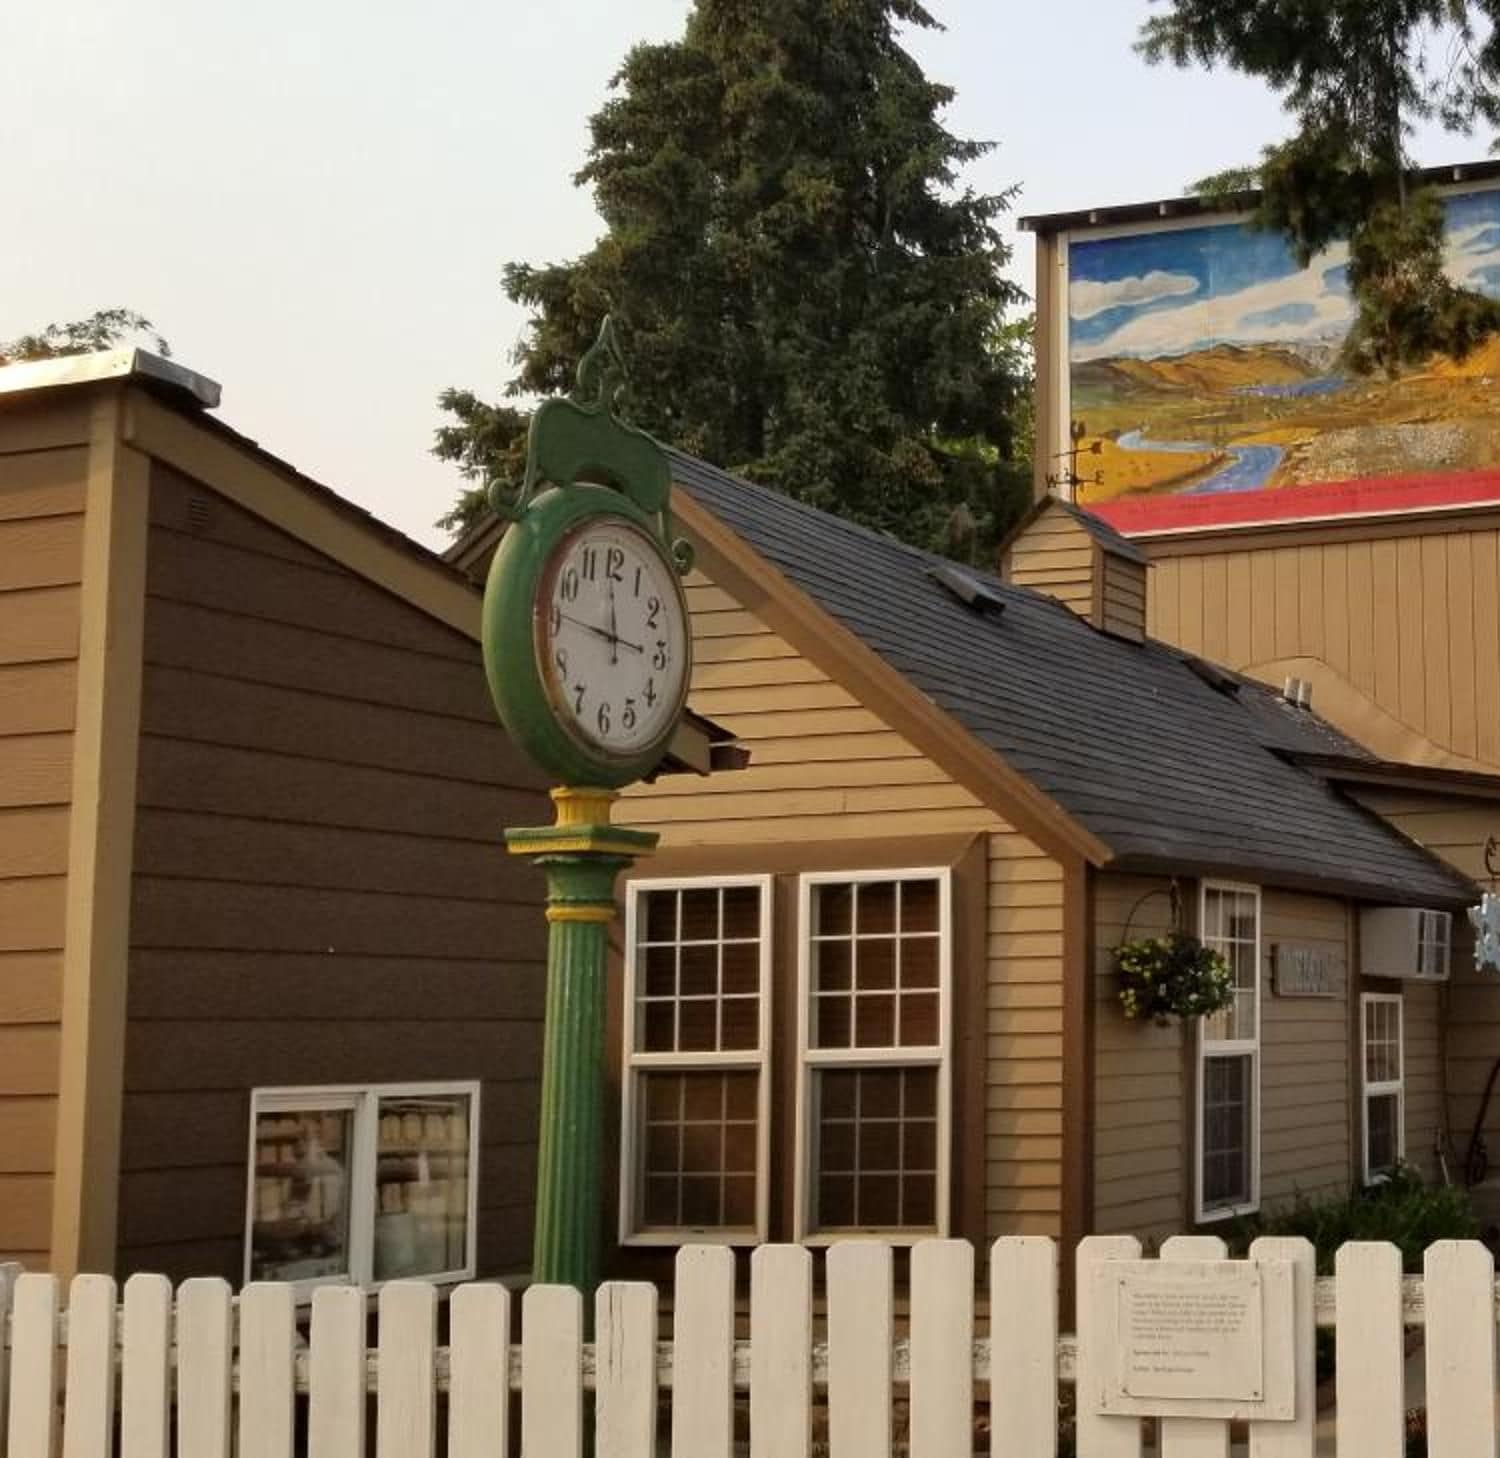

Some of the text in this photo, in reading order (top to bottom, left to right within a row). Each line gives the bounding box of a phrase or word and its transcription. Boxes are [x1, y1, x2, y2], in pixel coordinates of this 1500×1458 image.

[582, 547, 595, 581] 11
[606, 547, 625, 582] 12
[561, 568, 579, 602] 10
[635, 567, 641, 597] 1
[646, 599, 660, 630] 2
[556, 648, 567, 680] 8
[653, 640, 667, 670] 3
[573, 684, 586, 715] 7
[642, 678, 657, 707] 4
[597, 702, 611, 735] 6
[622, 699, 636, 729] 5
